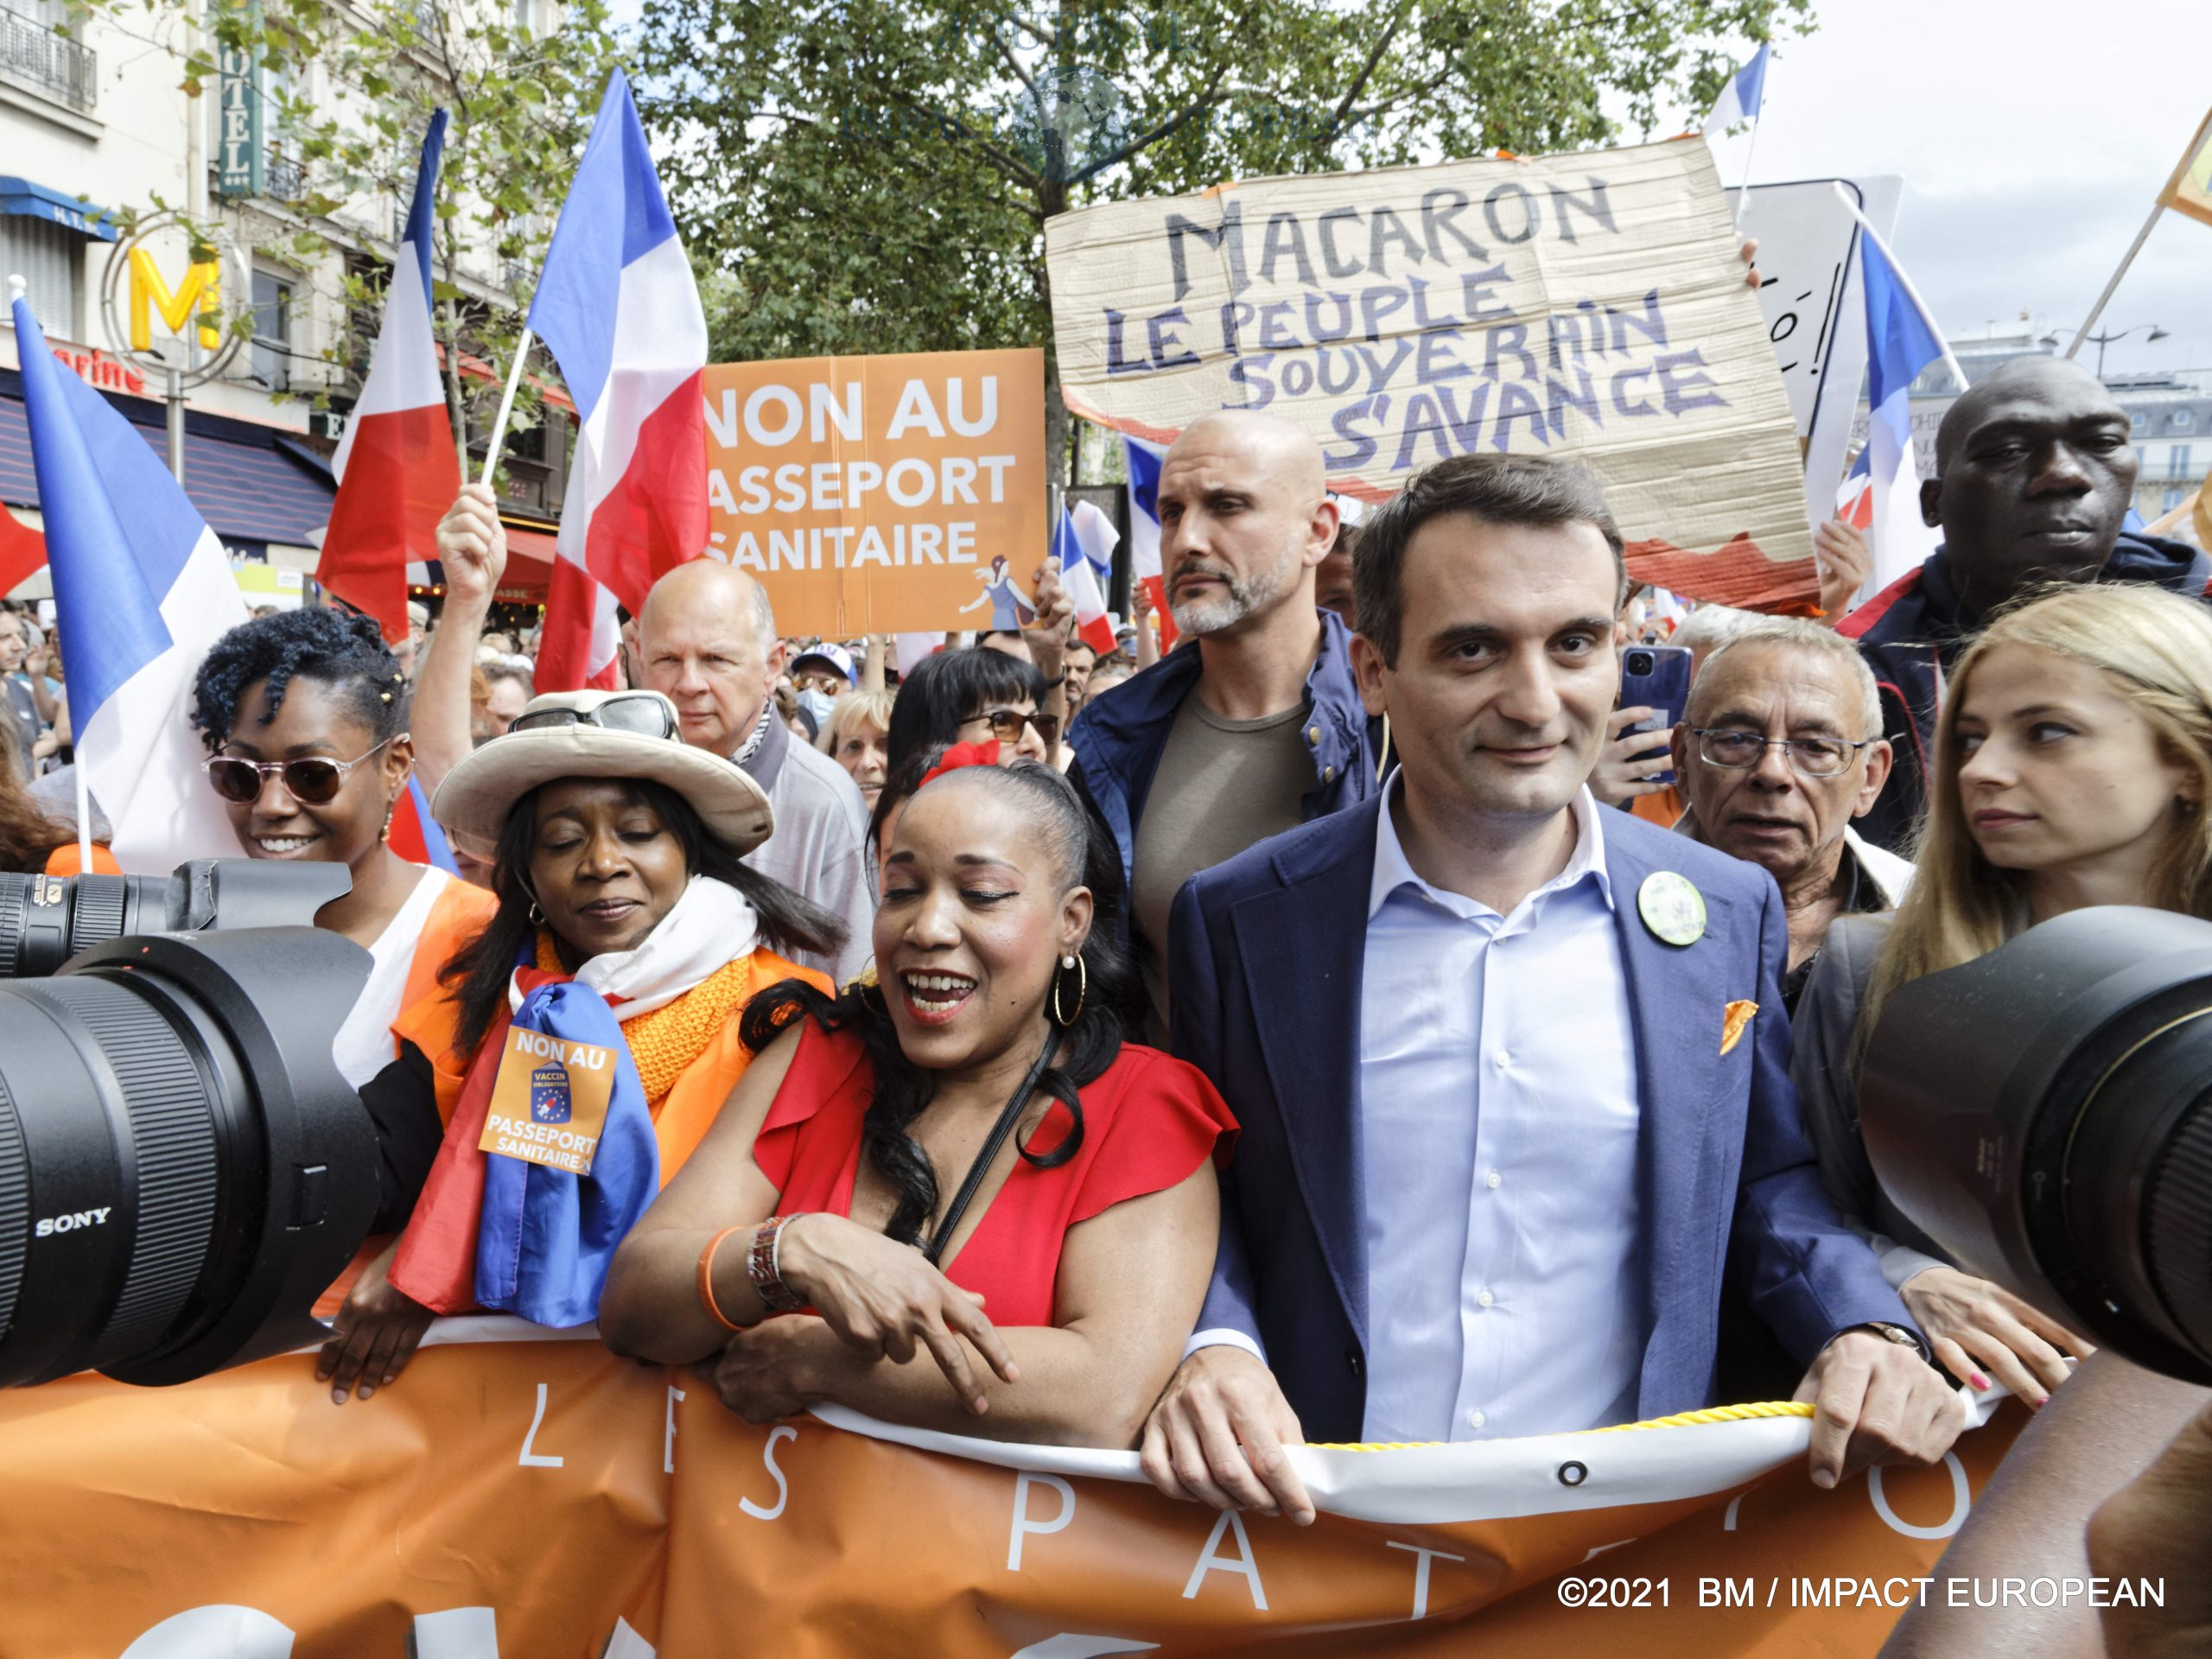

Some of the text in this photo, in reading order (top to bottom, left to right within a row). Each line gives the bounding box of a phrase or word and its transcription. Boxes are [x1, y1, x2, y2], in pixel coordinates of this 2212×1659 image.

[220, 41, 254, 173] OTEL
[1165, 175, 1619, 302] MACARON
[128, 245, 221, 352] M
[1103, 263, 1515, 374] LE PEUPLE
[54, 348, 145, 395] arine
[703, 375, 998, 448] NON AU
[708, 454, 1016, 515] ASSEPORT
[517, 1032, 607, 1070] NON AU
[534, 1072, 565, 1081] VACCIN
[487, 1114, 596, 1154] PASSEPORT
[496, 1137, 581, 1169] SANITAIRE
[35, 1206, 111, 1237] SONY
